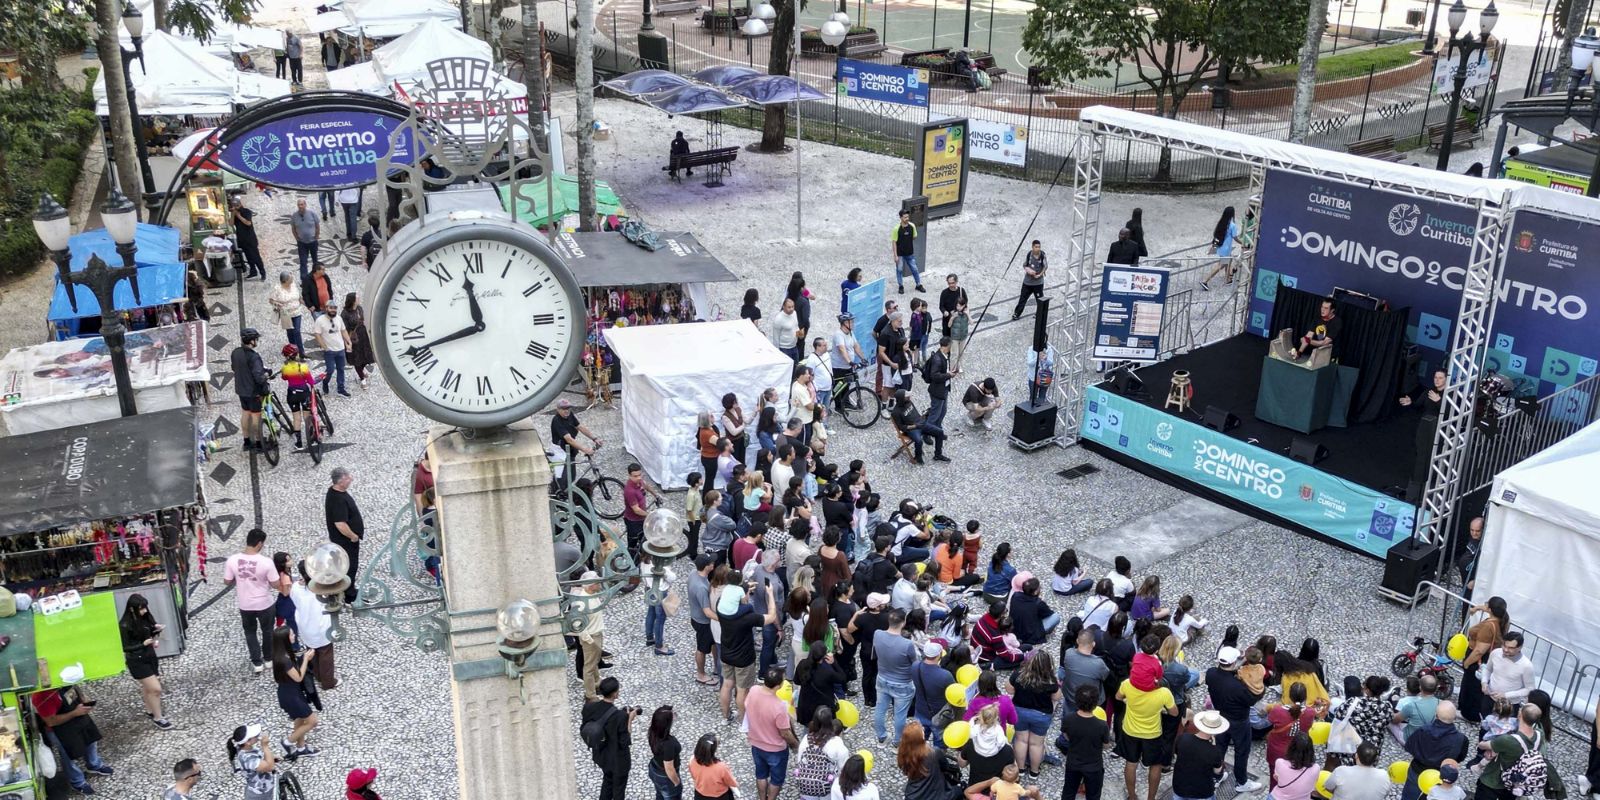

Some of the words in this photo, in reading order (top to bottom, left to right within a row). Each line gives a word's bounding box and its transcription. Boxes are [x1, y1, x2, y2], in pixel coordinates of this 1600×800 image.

[859, 72, 905, 85] DOMINGO
[866, 82, 905, 94] CENTRO
[321, 121, 353, 129] ESPECIAL
[285, 131, 376, 151] Inverno
[285, 149, 377, 170] Curitiba
[928, 163, 958, 174] DOMINGO
[931, 169, 958, 179] CENTRO
[1308, 192, 1352, 211] CURITIBA
[1426, 213, 1475, 235] Inverno
[1420, 225, 1473, 247] Curitiba
[1281, 226, 1425, 279] DOMINGO
[1425, 261, 1441, 285] NO
[1540, 245, 1577, 259] CURITIBA
[463, 253, 484, 274] XII
[501, 259, 513, 279] I
[429, 262, 453, 287] XI
[522, 281, 543, 297] II
[406, 291, 431, 309] X
[533, 313, 554, 325] III
[402, 324, 425, 340] IX
[440, 368, 461, 393] VII
[509, 366, 526, 385] V
[476, 375, 494, 396] VI
[1147, 443, 1171, 458] Curitiba
[1149, 438, 1173, 452] Inverno
[1193, 440, 1286, 483] DOMINGO
[1203, 460, 1283, 499] CENTRO
[1318, 497, 1346, 513] CURITIBA
